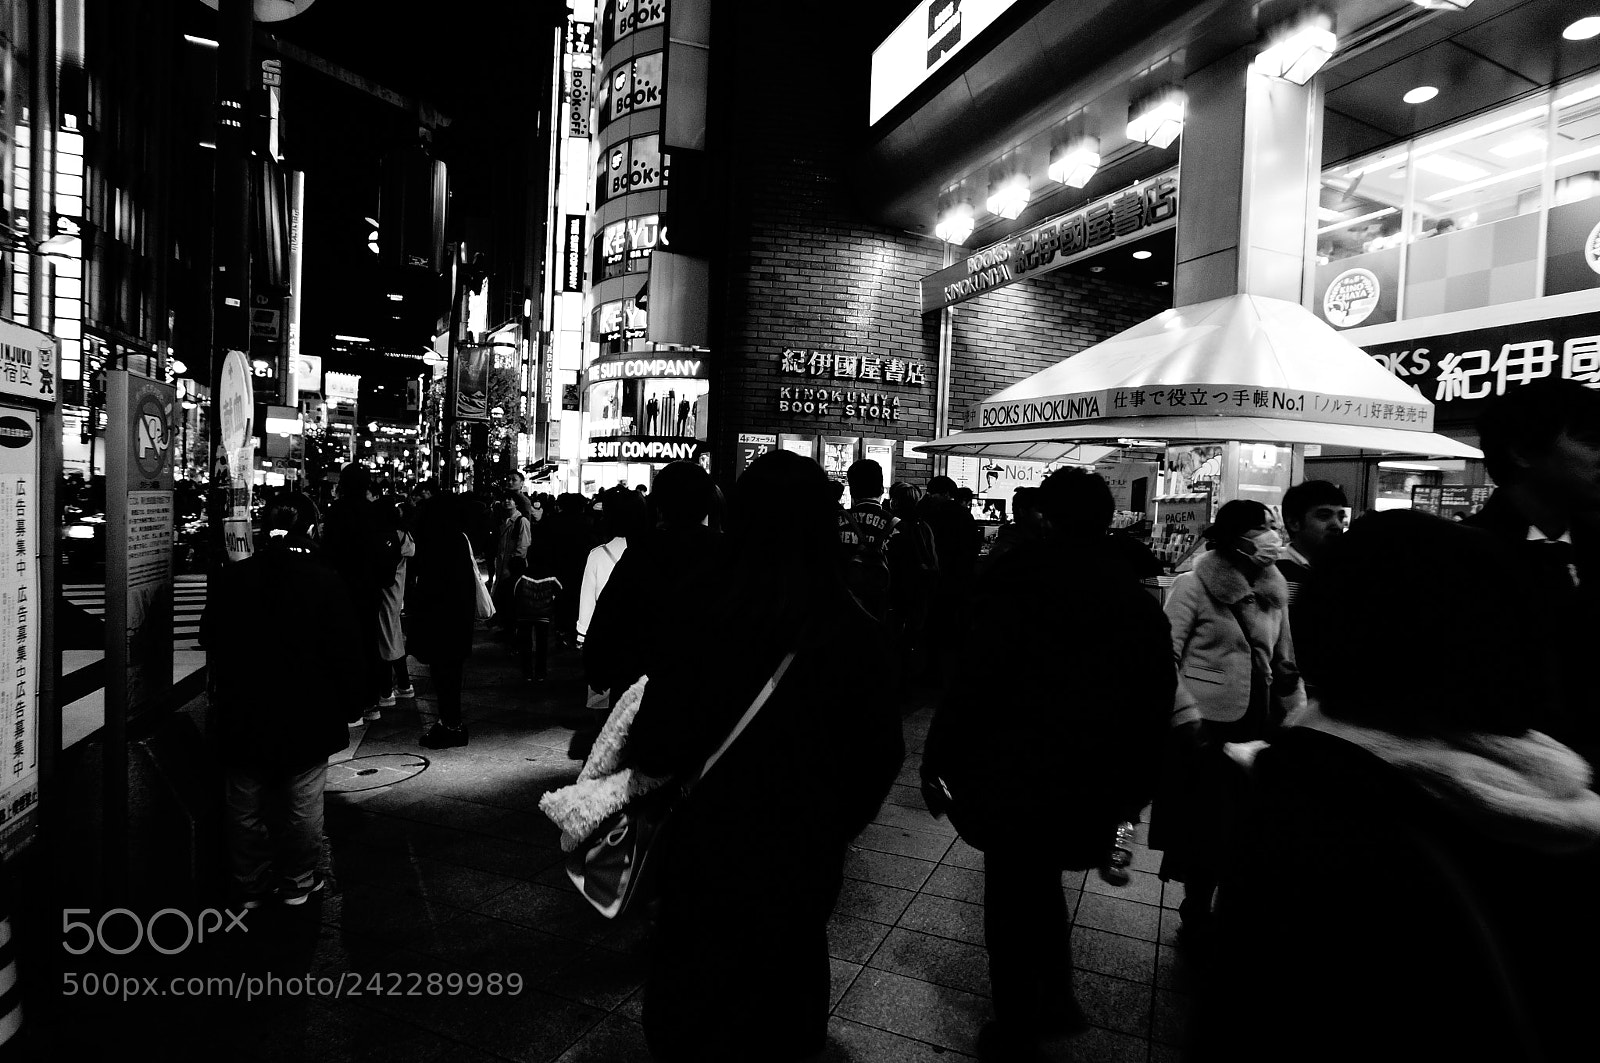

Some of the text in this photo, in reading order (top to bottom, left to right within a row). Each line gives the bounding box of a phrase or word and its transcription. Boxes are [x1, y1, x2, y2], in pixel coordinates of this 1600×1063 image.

[1013, 177, 1176, 274] 紀伊國屋書店
[967, 243, 1010, 275] BOOKS
[944, 263, 1013, 302] KINOKUNIYA
[1339, 283, 1364, 294] KINO
[1335, 290, 1367, 302] CHAYA
[0, 362, 32, 386] 宿区
[600, 361, 624, 379] SUIT
[625, 359, 700, 376] COMPANY
[781, 347, 927, 385] 紀伊國屋書店
[780, 387, 901, 407] KINOKUNIYA
[779, 400, 901, 421] BOOK STORE
[981, 396, 1099, 427] BOOKS KINOKUNIYA
[597, 442, 621, 457] SUIT
[621, 441, 697, 459] COMPANY
[1005, 464, 1032, 481] No.1
